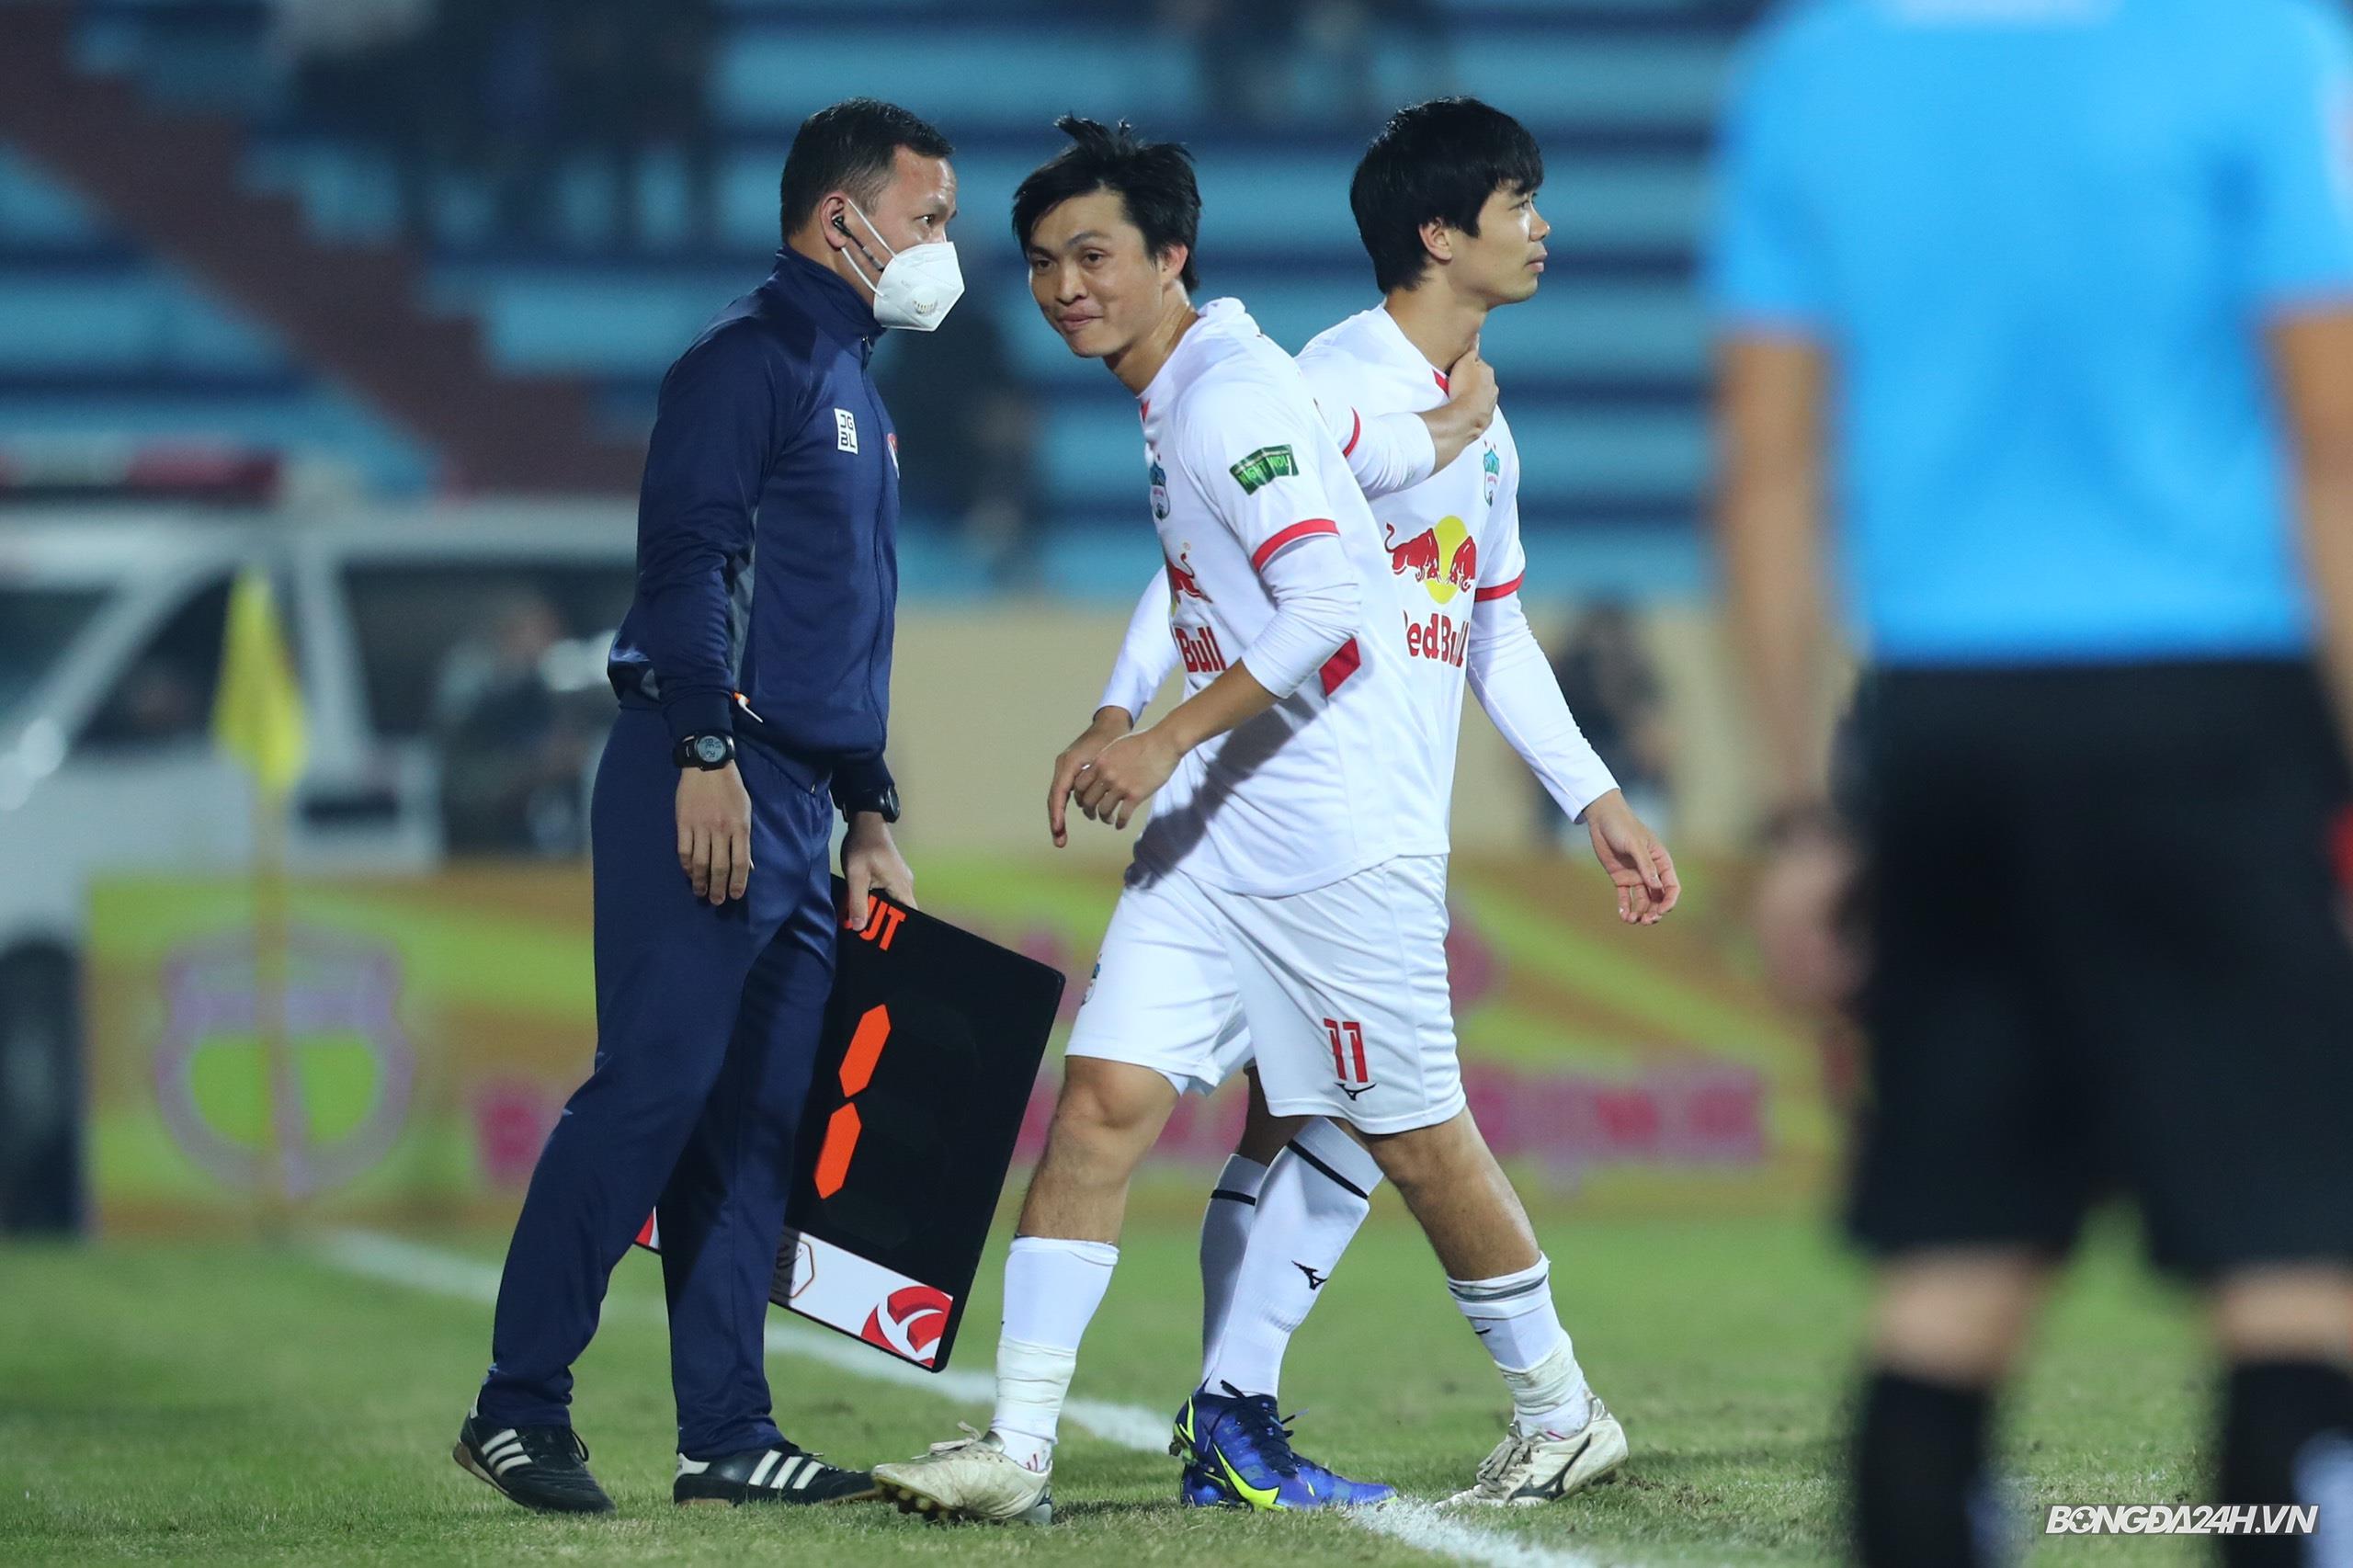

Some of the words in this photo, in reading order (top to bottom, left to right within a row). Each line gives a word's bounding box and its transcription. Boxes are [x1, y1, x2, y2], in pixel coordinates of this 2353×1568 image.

[840, 414, 854, 430] JG
[840, 431, 856, 449] BL
[1175, 626, 1227, 673] Bull
[844, 895, 906, 950] UT
[1324, 1017, 1369, 1083] 11
